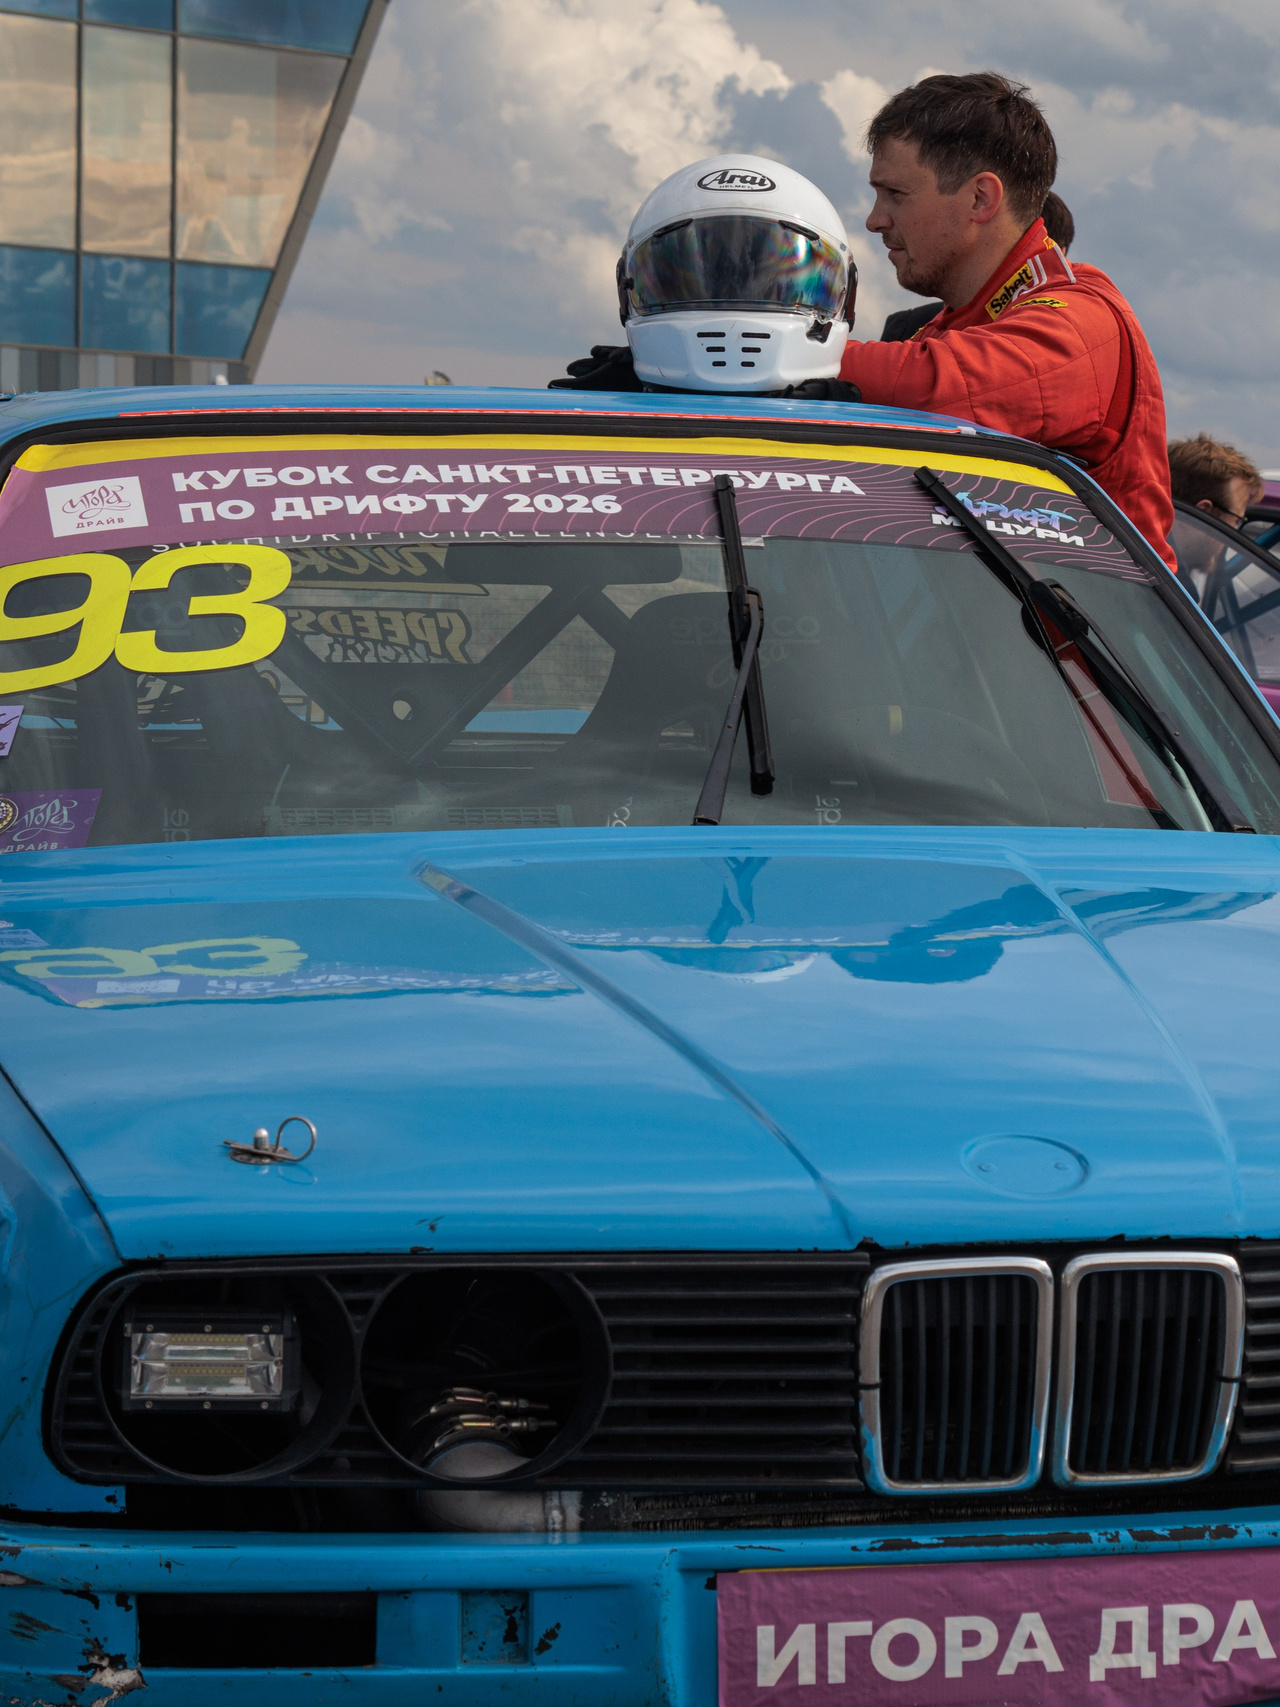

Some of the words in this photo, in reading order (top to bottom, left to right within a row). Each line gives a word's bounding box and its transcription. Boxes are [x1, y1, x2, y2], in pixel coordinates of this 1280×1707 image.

[703, 170, 768, 187] Arai
[990, 266, 1034, 314] Sabelt
[172, 465, 353, 492] КУБОК
[76, 516, 125, 529] ДРАЙВ
[179, 499, 255, 524] ПО
[271, 493, 489, 522] ДРИФТУ
[503, 493, 623, 515] 2026
[931, 513, 1085, 547] МЦУРИ
[0, 544, 292, 695] 93
[757, 1611, 1064, 1688] ИГОРА
